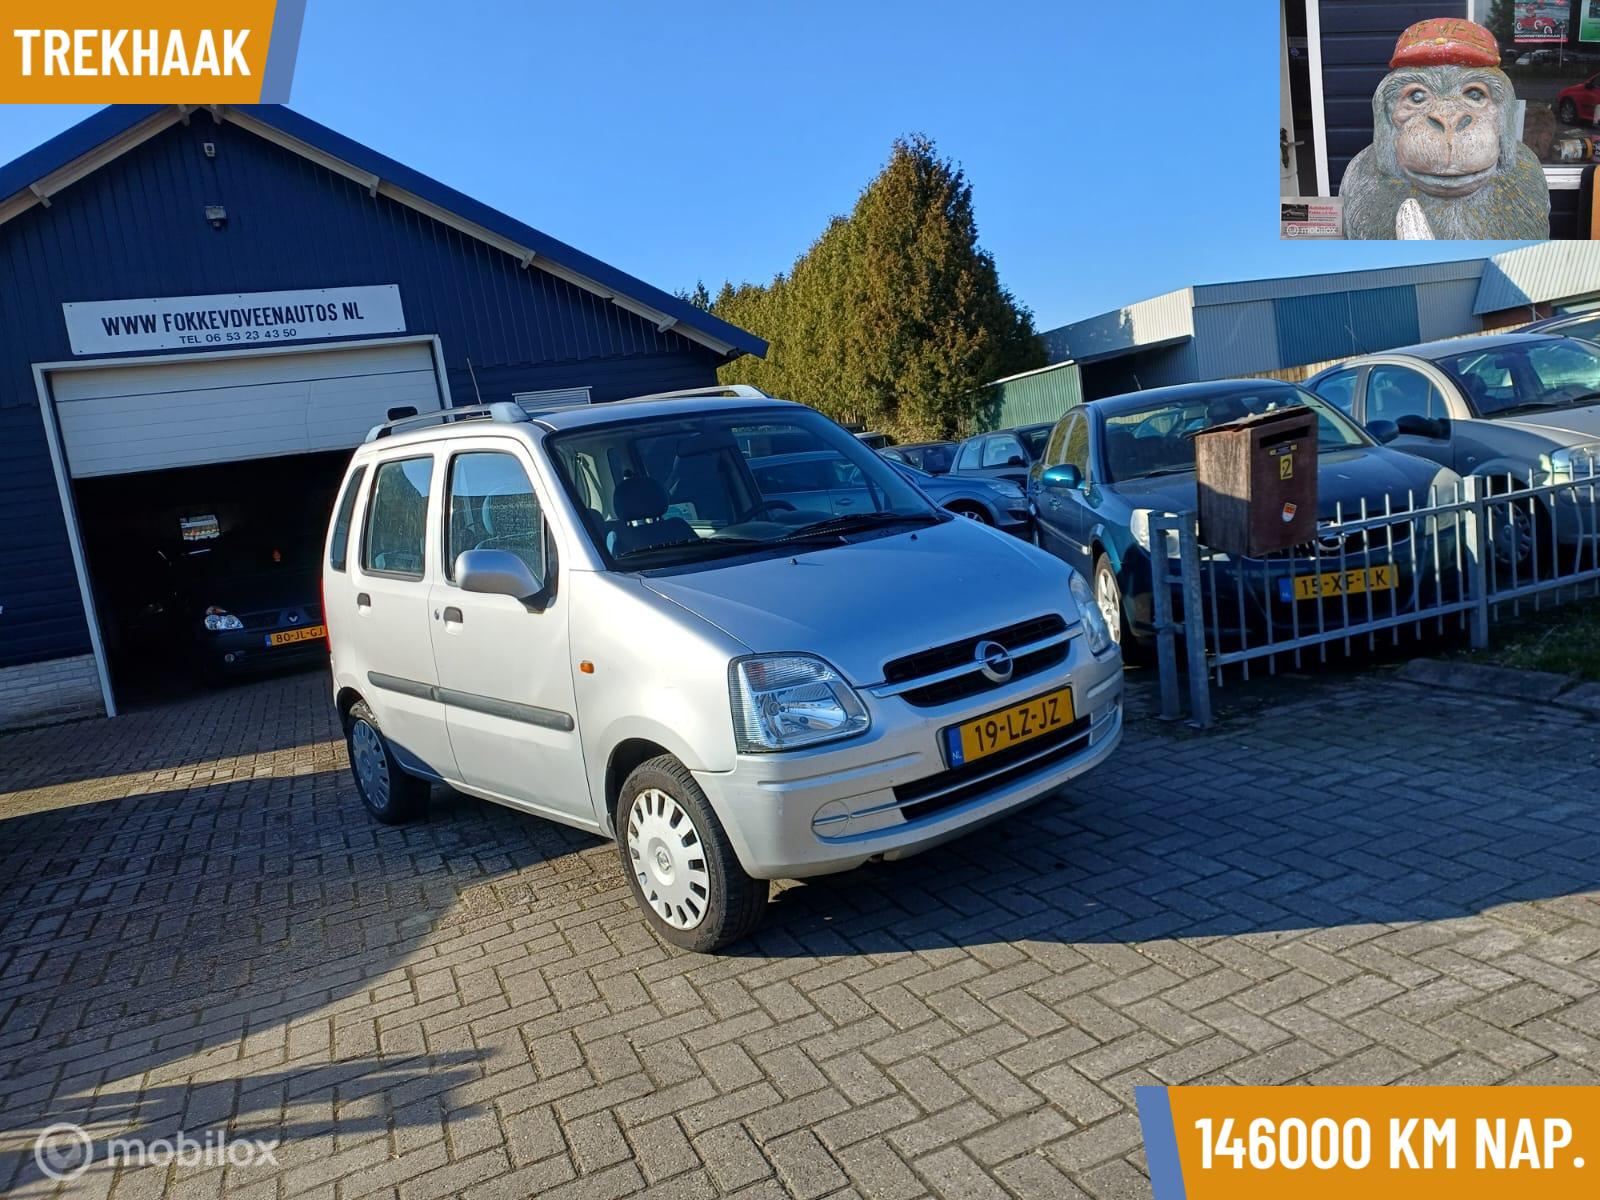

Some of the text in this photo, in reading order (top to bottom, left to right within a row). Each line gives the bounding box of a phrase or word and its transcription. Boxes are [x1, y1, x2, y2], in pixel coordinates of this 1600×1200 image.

[101, 301, 364, 337] WWW FOKKEVDVEENAUTOS NL
[179, 328, 297, 345] TEL 06 53 23 43 50
[1281, 458, 1292, 478] 2
[276, 629, 323, 643] 80-JL-GJ
[952, 697, 1061, 760] NL 19-LZ-JZ
